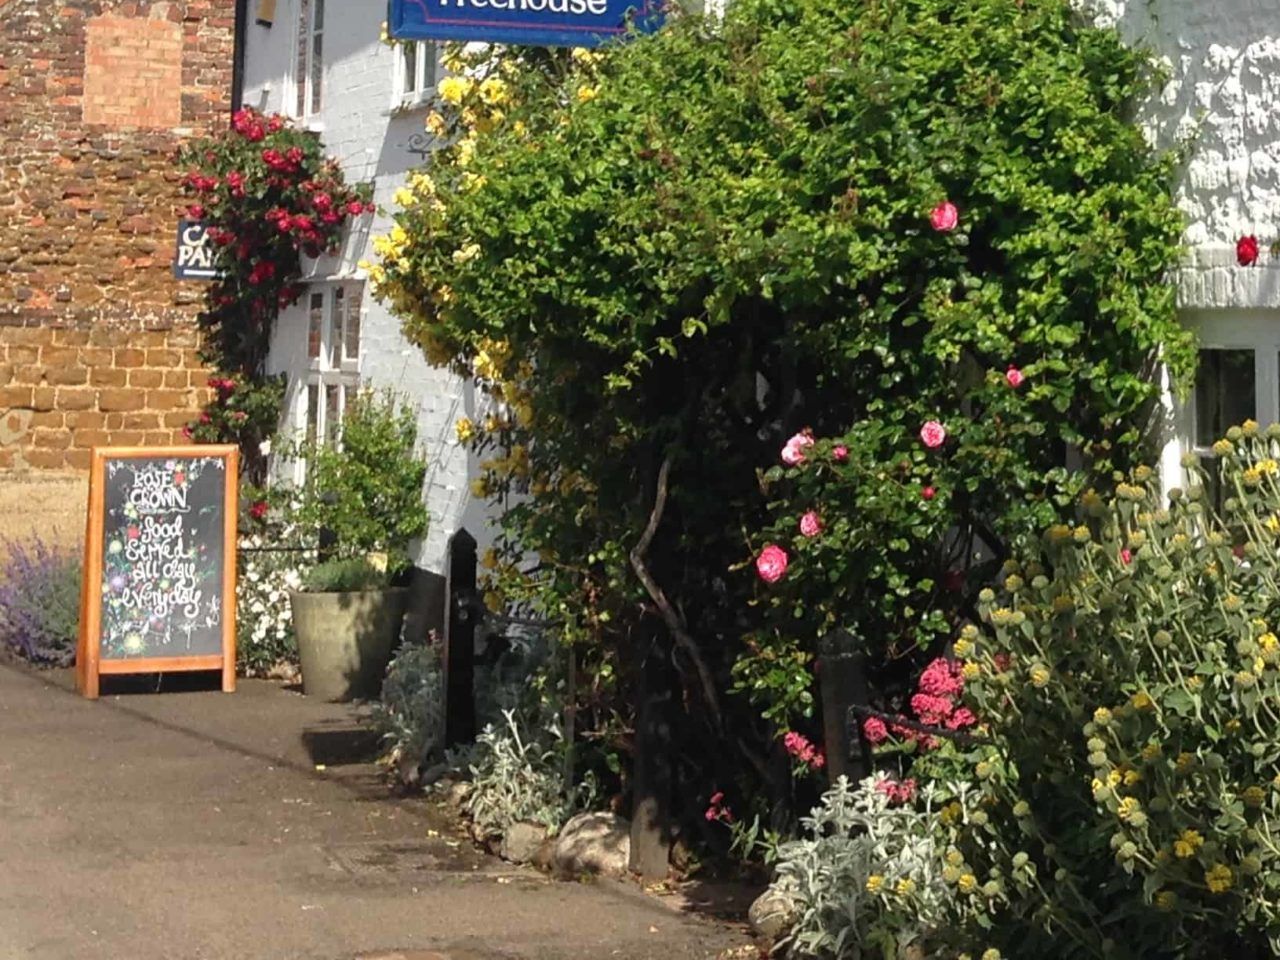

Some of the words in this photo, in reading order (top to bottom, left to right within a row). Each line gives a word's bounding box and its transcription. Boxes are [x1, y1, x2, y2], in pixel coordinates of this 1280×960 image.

[132, 470, 174, 488] ROSE
[130, 487, 187, 508] CROWN
[141, 515, 183, 542] food
[132, 560, 159, 582] all
[163, 559, 195, 590] day
